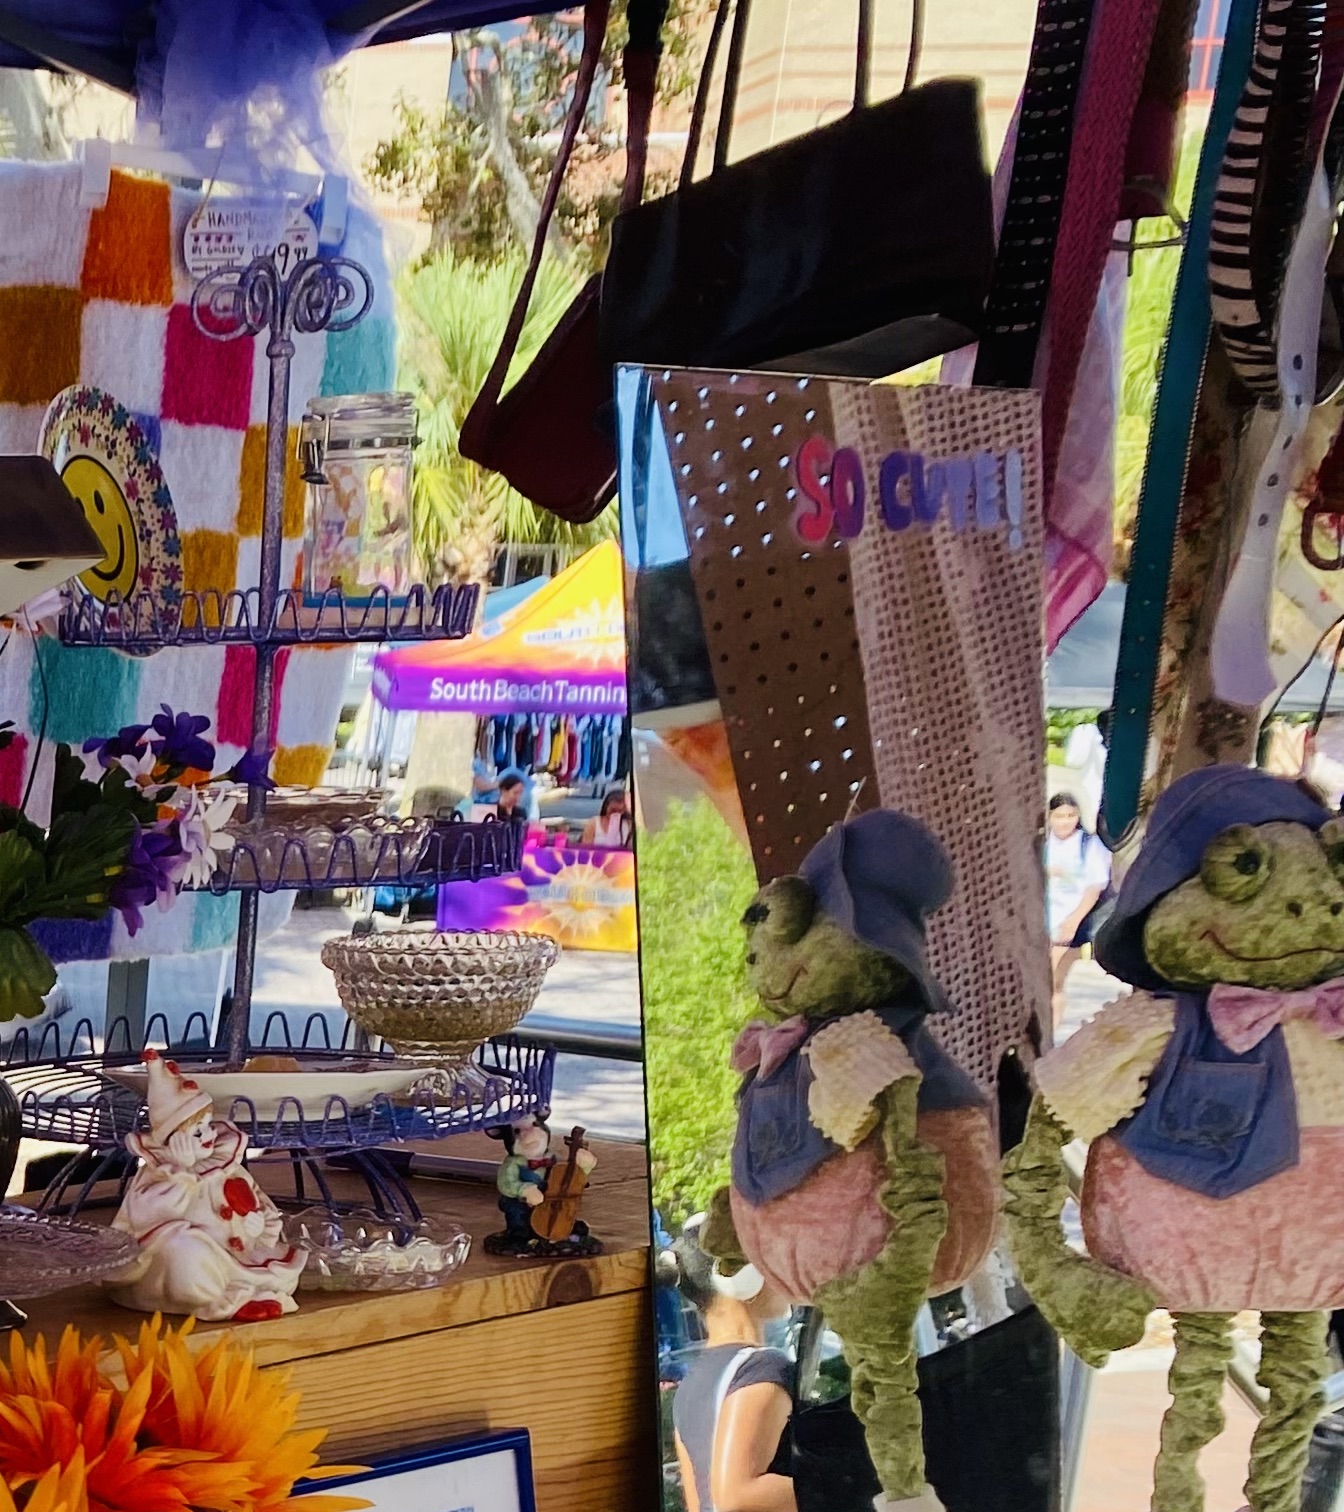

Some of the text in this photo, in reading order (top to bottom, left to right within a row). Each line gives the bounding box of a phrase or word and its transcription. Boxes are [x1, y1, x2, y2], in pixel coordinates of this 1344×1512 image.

[797, 436, 864, 542] SO
[430, 677, 626, 703] South Beach Tannin
